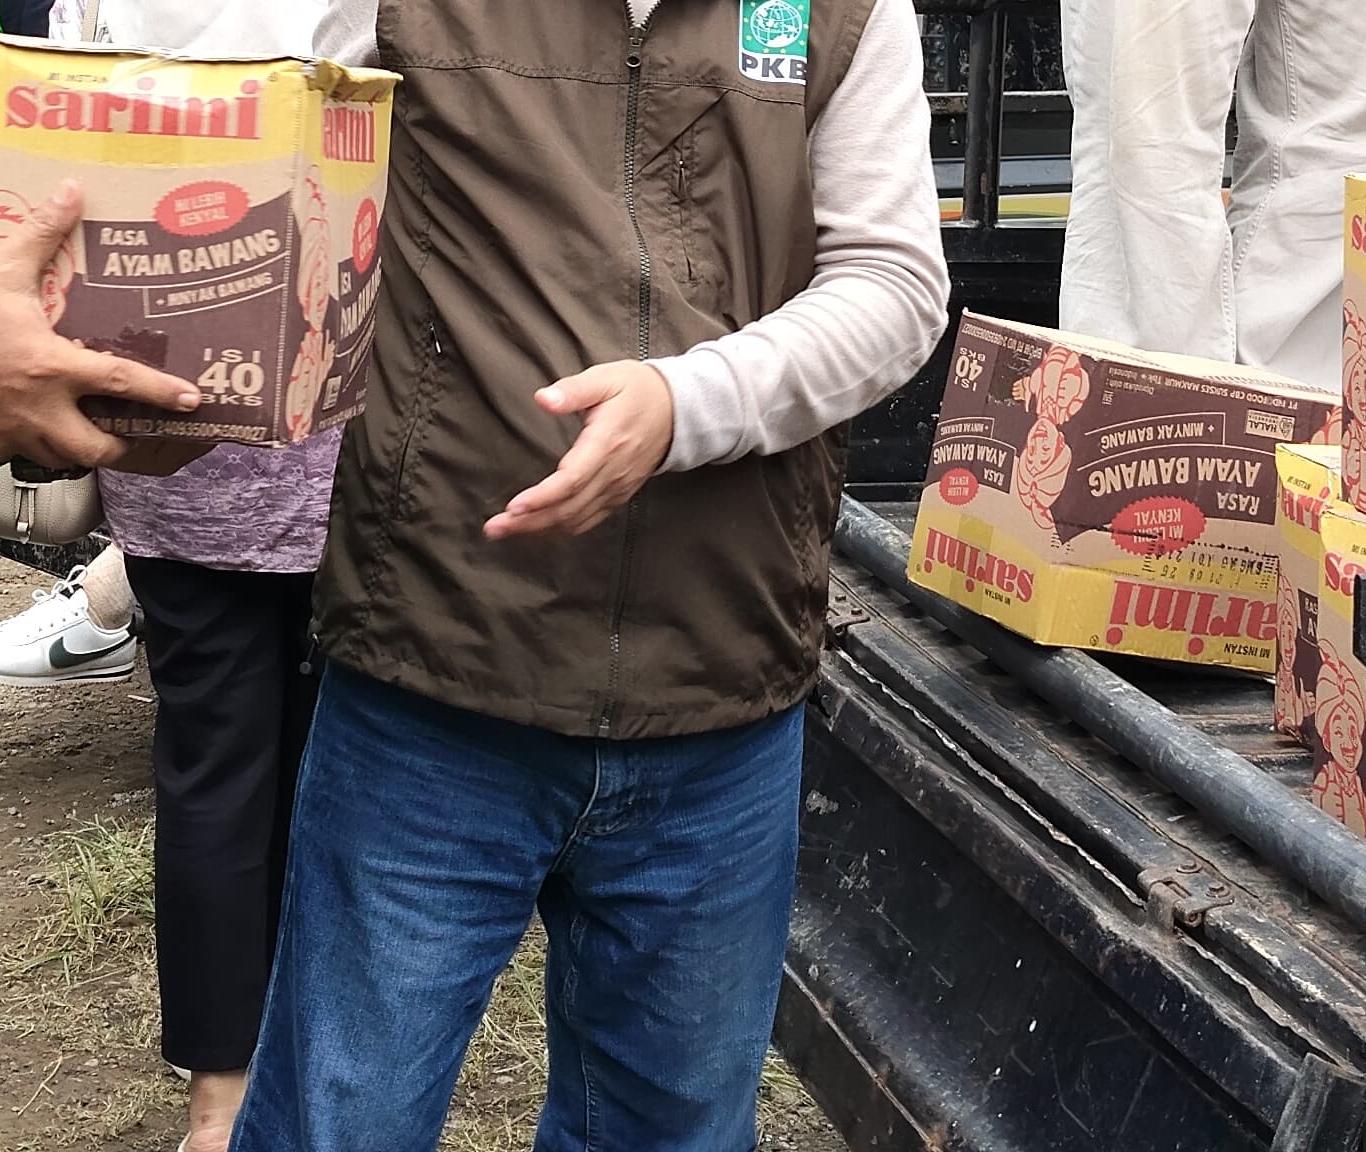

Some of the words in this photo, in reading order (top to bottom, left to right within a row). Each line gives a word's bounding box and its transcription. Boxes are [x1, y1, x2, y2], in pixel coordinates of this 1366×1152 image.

[741, 53, 807, 80] PKB
[6, 77, 262, 140] sarimi
[99, 228, 149, 246] RASA
[102, 252, 175, 277] AYAM
[176, 229, 281, 275] BAWANG
[203, 348, 263, 363] ISI
[959, 347, 986, 362] BKS
[197, 362, 265, 396] 40
[955, 356, 983, 382] 40
[954, 375, 977, 392] ISI
[1165, 375, 1200, 393] MAKMUR
[199, 394, 265, 407] BKS
[1157, 422, 1205, 440] MINYAK
[1248, 419, 1277, 433] HALAL
[1100, 425, 1154, 449] BAWANG
[933, 443, 975, 465] BAWANG
[976, 443, 1008, 468] AYAM
[983, 467, 1005, 486] RASA
[1088, 457, 1191, 498] BAWANG
[1197, 457, 1262, 488] AYAM
[1217, 491, 1261, 516] RASA
[1281, 487, 1331, 535] ari
[1134, 508, 1183, 527] KENYAL
[1351, 544, 1360, 554] MI
[924, 527, 1035, 603] sarimi
[1304, 598, 1318, 615] RAS
[1105, 580, 1278, 656] arimi
[1224, 642, 1260, 658] INSTAN
[1260, 647, 1271, 659] MI
